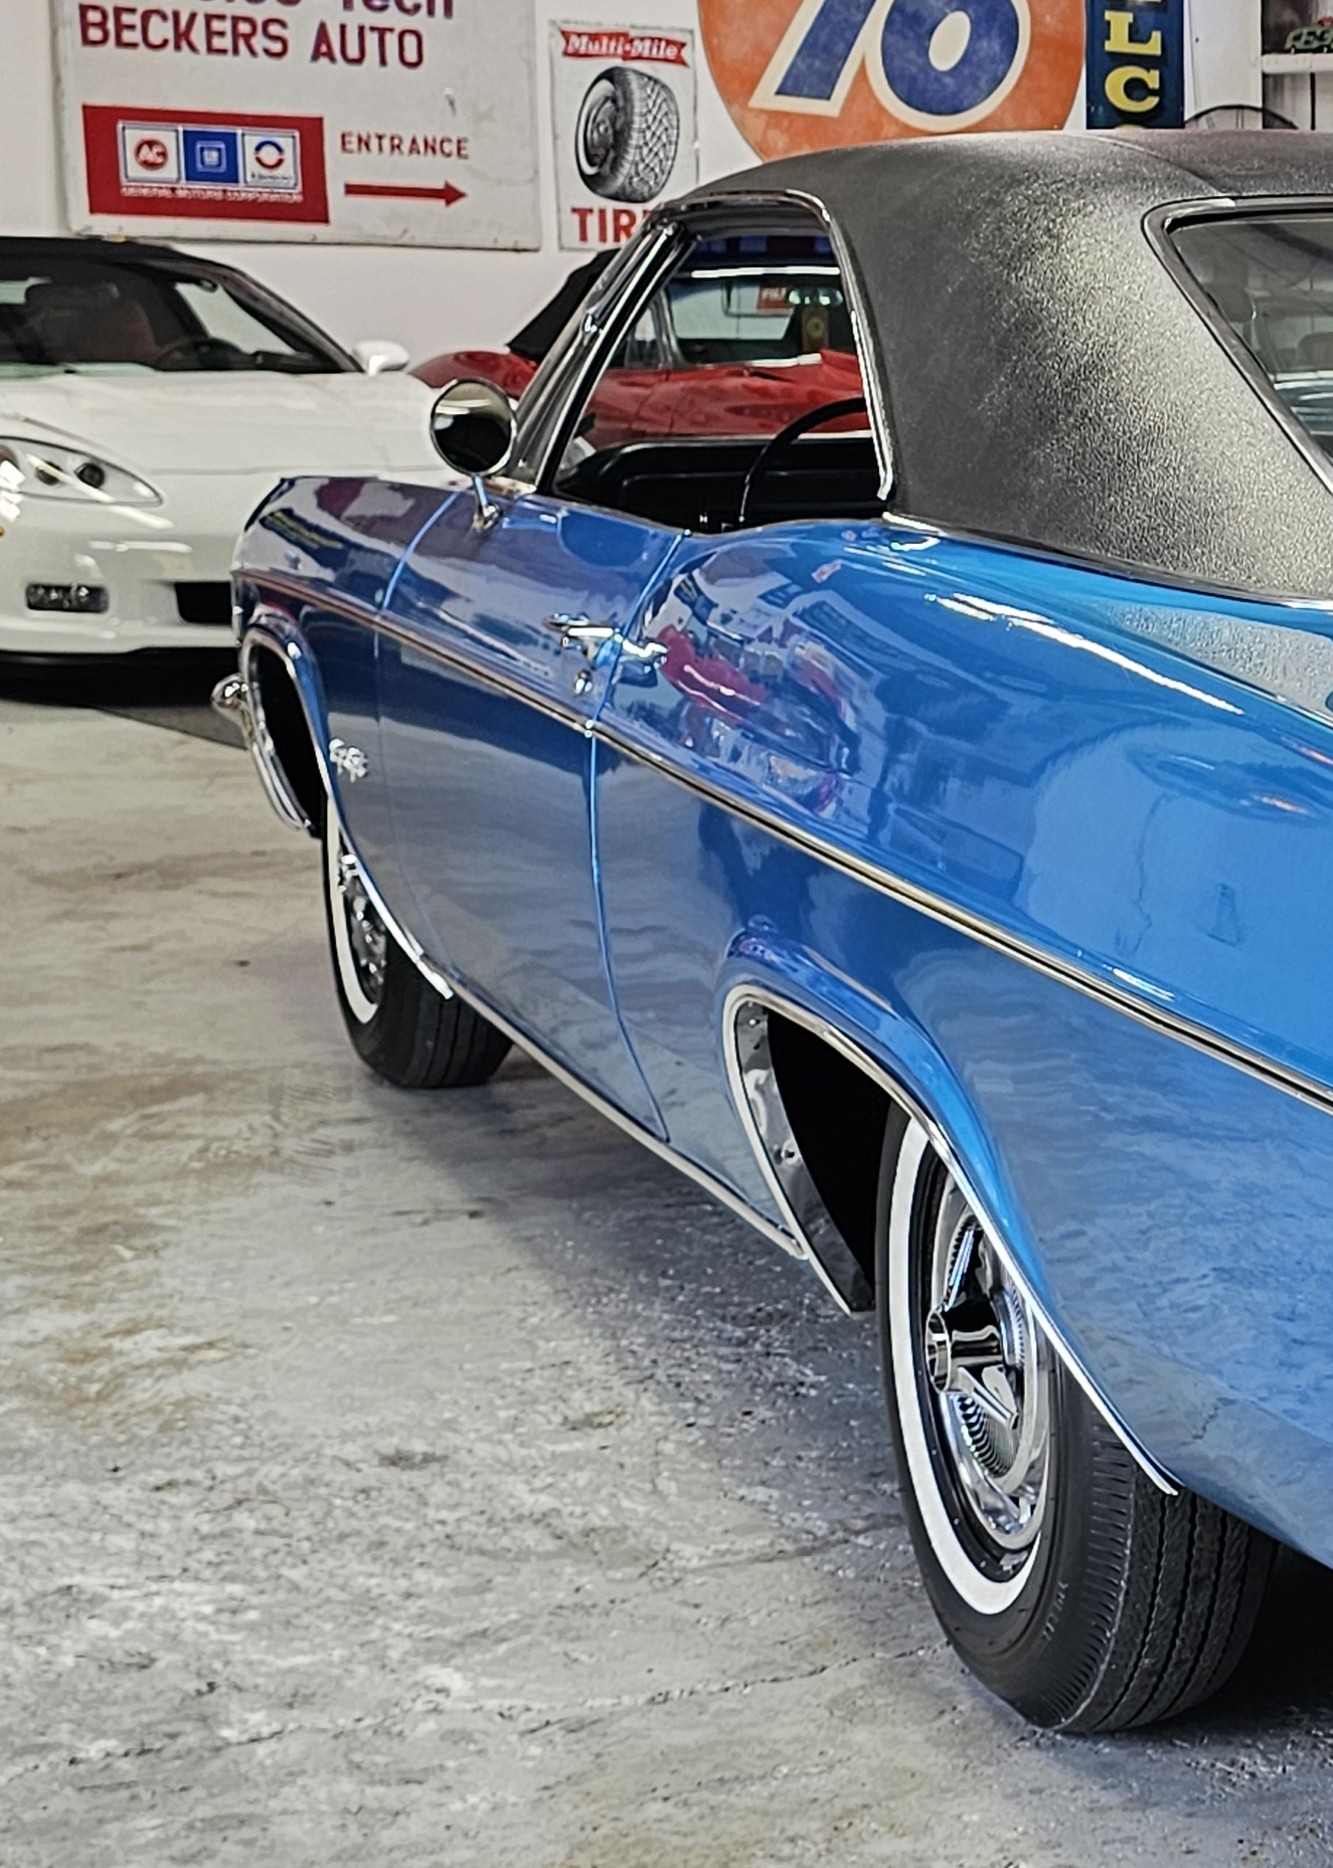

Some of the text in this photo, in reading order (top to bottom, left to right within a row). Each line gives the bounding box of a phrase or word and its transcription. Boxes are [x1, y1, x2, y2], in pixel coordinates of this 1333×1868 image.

[78, 2, 424, 69] BECKERS AUTO
[340, 130, 469, 160] ENTRANCE
[571, 207, 651, 243] TIR
